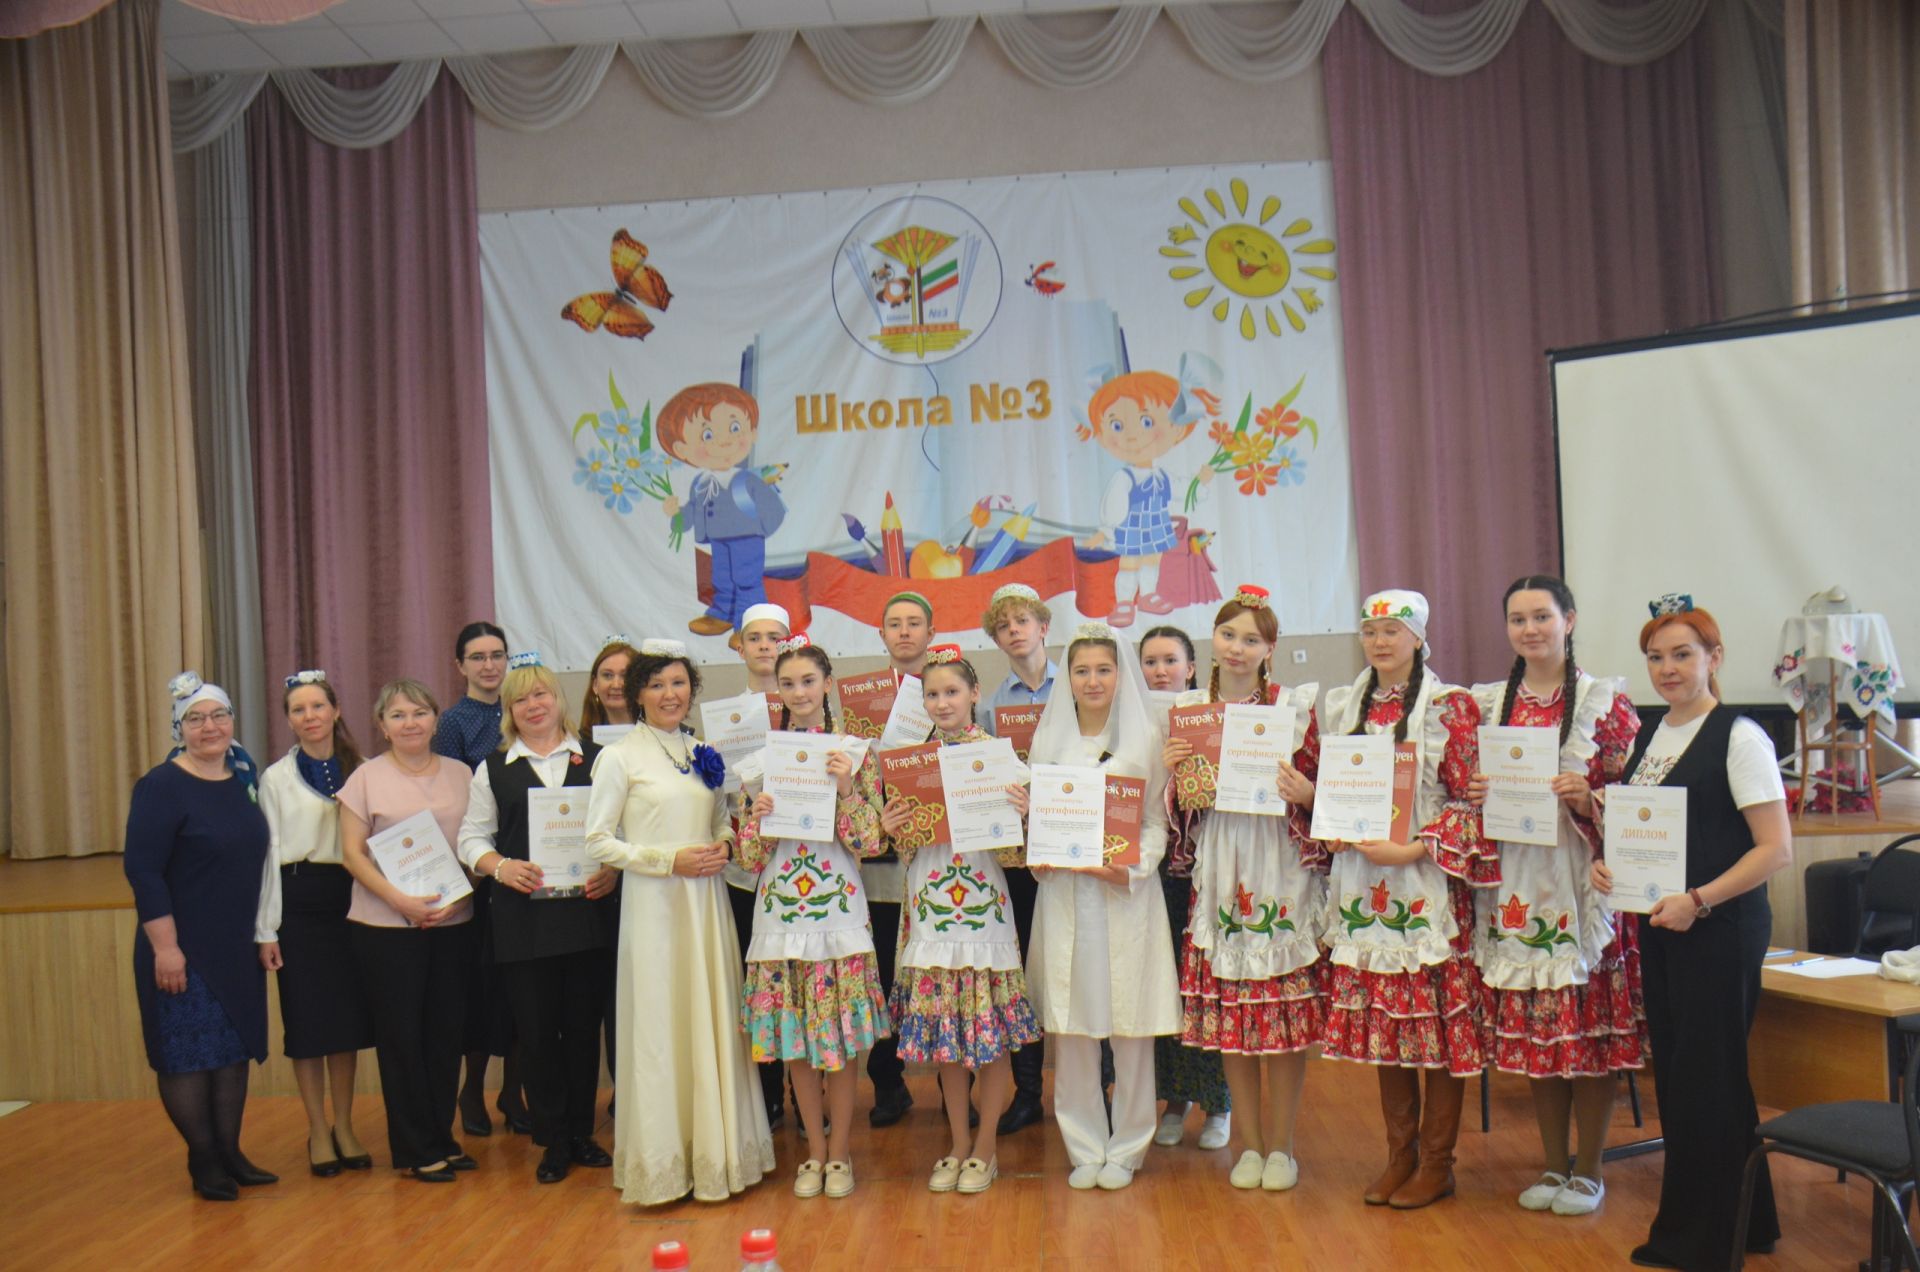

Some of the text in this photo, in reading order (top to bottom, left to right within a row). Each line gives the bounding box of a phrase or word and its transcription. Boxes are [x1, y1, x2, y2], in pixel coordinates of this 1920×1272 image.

[795, 379, 1052, 435] Школа №3
[544, 820, 585, 831] ДИПЛОМ
[1621, 827, 1668, 841] ДИПЛОМ
